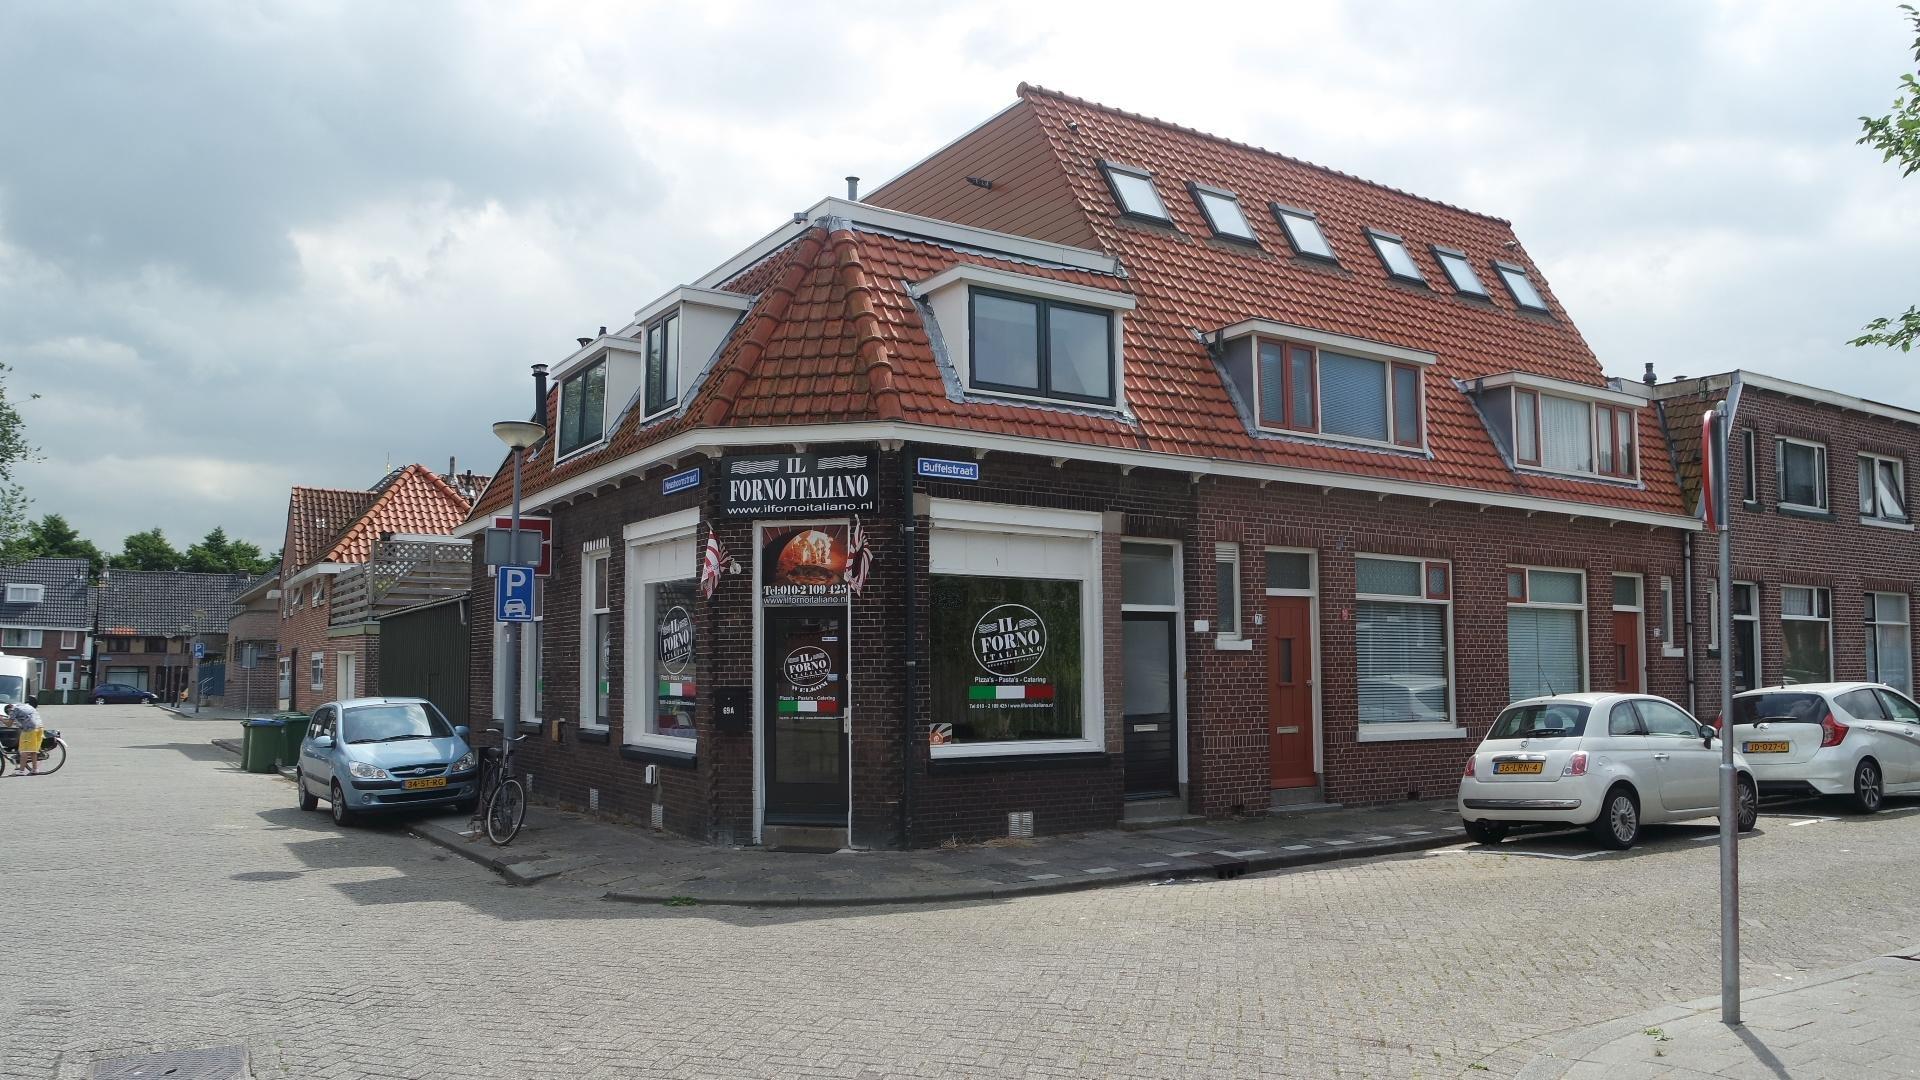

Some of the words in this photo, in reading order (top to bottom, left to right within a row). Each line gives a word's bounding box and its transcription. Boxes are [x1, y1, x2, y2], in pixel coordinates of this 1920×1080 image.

[786, 458, 806, 473] IL
[922, 461, 974, 475] Buffelstraat
[730, 477, 786, 501] FORNO
[790, 474, 868, 499] ITALIANO
[728, 501, 873, 514] www.ilfornoitaliano.nl
[506, 570, 526, 596] P
[809, 585, 826, 594] 109
[828, 584, 846, 594] 425
[670, 618, 680, 634] IL
[998, 617, 1018, 633] IL
[663, 629, 689, 653] FORNO
[981, 629, 1040, 653] FORNO
[800, 654, 813, 662] IL
[983, 646, 1042, 662] ITALIANO
[789, 660, 827, 674] FORNO
[1750, 743, 1786, 751] JD-027-G
[1500, 763, 1538, 771] 36-LRN-4
[407, 779, 444, 788] 34-ST-RG
